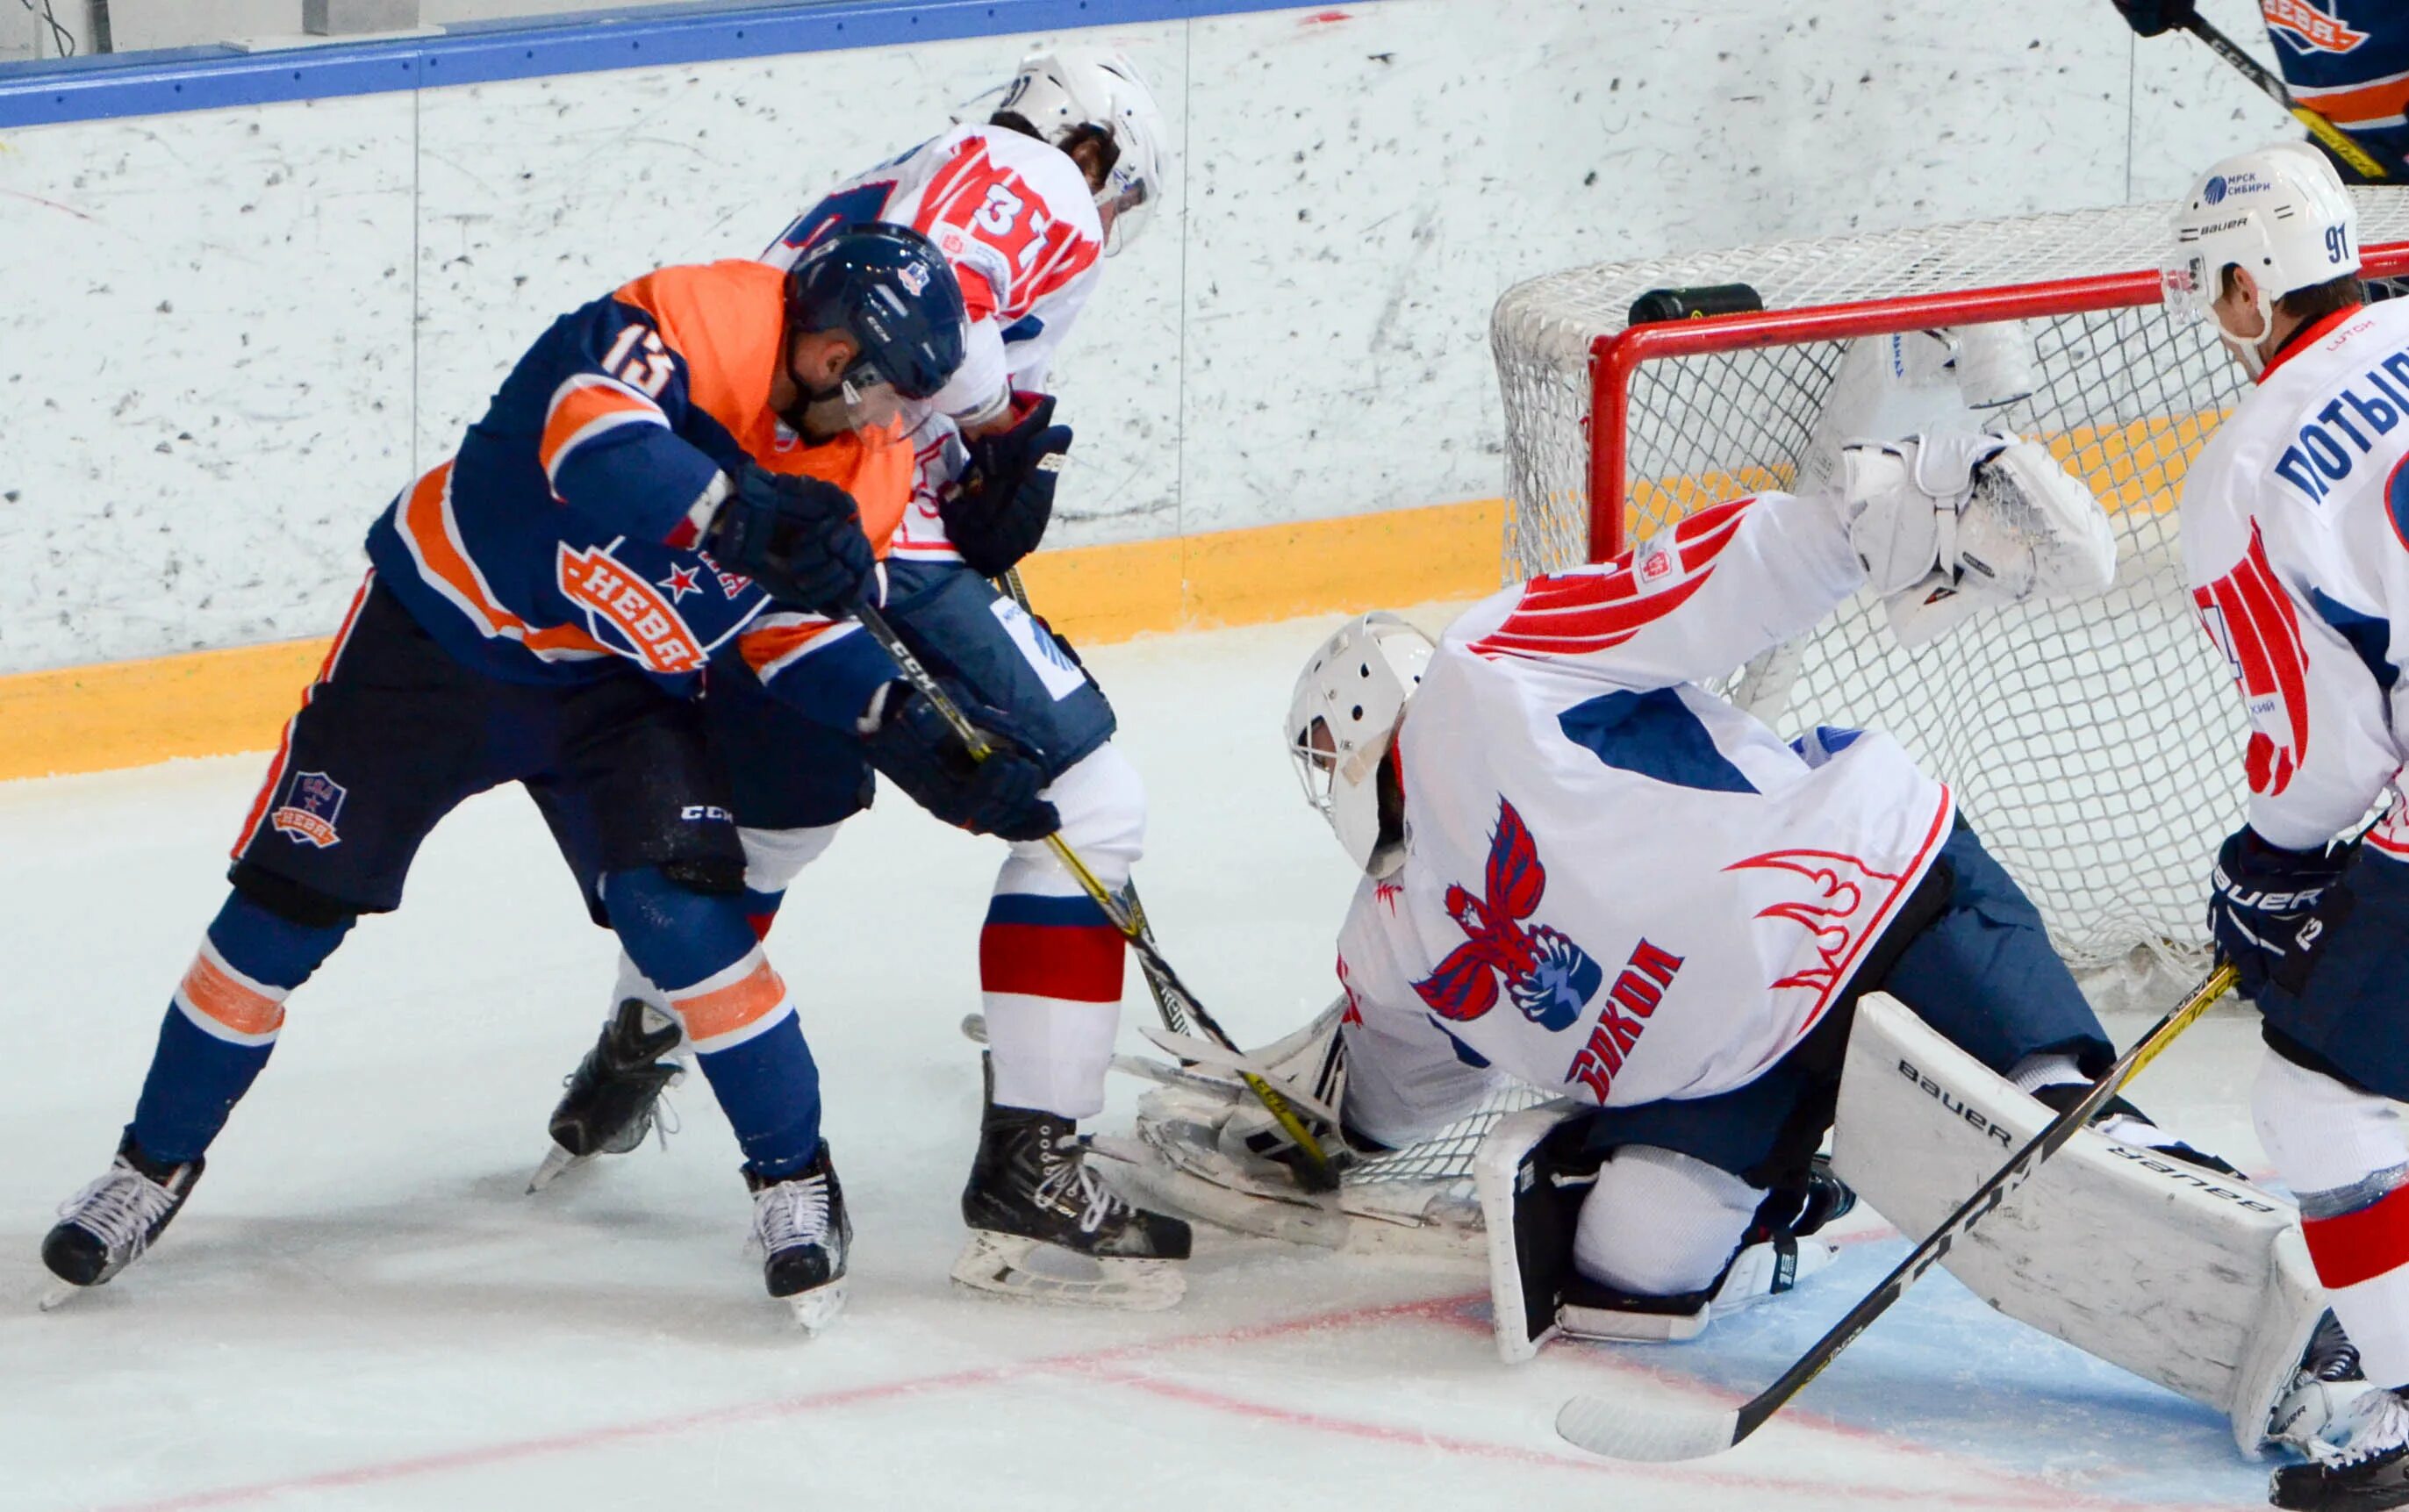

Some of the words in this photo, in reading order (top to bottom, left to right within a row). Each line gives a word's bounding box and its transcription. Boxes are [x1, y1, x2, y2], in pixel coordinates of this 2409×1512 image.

[2227, 182, 2271, 197] СИБИРИ
[2228, 173, 2256, 184] МРСК
[972, 183, 1050, 270] 37
[2325, 221, 2349, 264] 91
[2327, 319, 2375, 352] LUTCH
[600, 323, 676, 400] 13
[582, 565, 692, 665] НЕВА
[890, 641, 937, 691] CCM
[1564, 936, 1686, 1107] СОКОЛ
